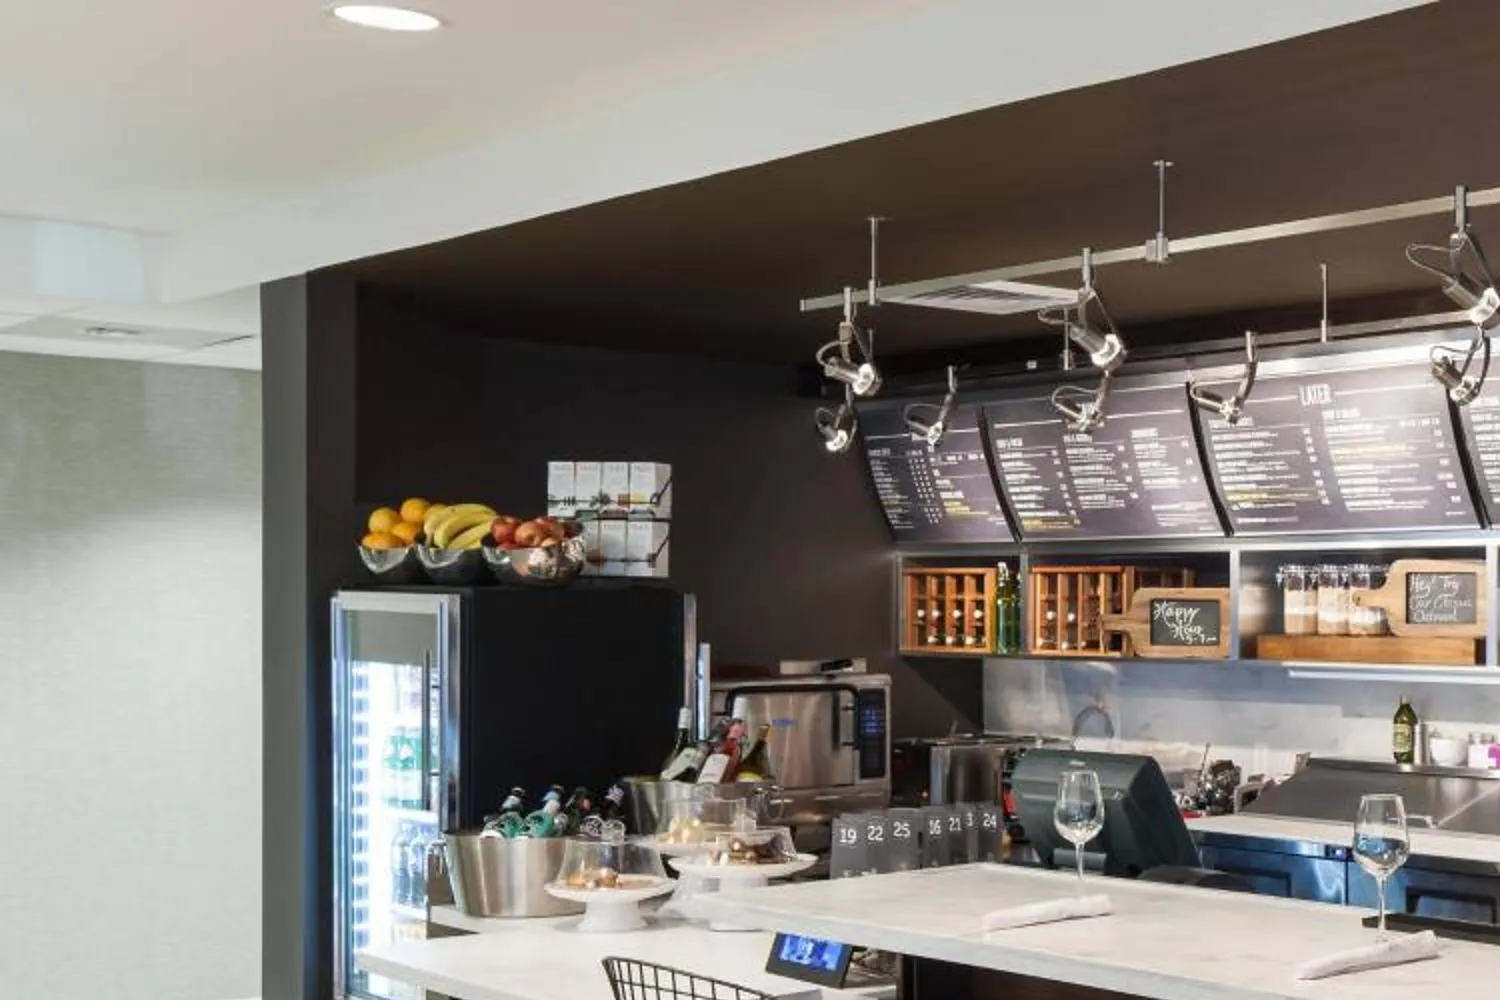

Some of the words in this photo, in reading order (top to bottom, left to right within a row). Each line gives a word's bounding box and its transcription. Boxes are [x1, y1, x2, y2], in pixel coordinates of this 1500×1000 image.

[1153, 600, 1201, 627] Happy
[929, 819, 941, 835] 16
[949, 817, 961, 831] 21
[983, 813, 997, 828] 24
[839, 827, 857, 844] 19
[867, 825, 884, 841] 22
[893, 821, 911, 838] 25
